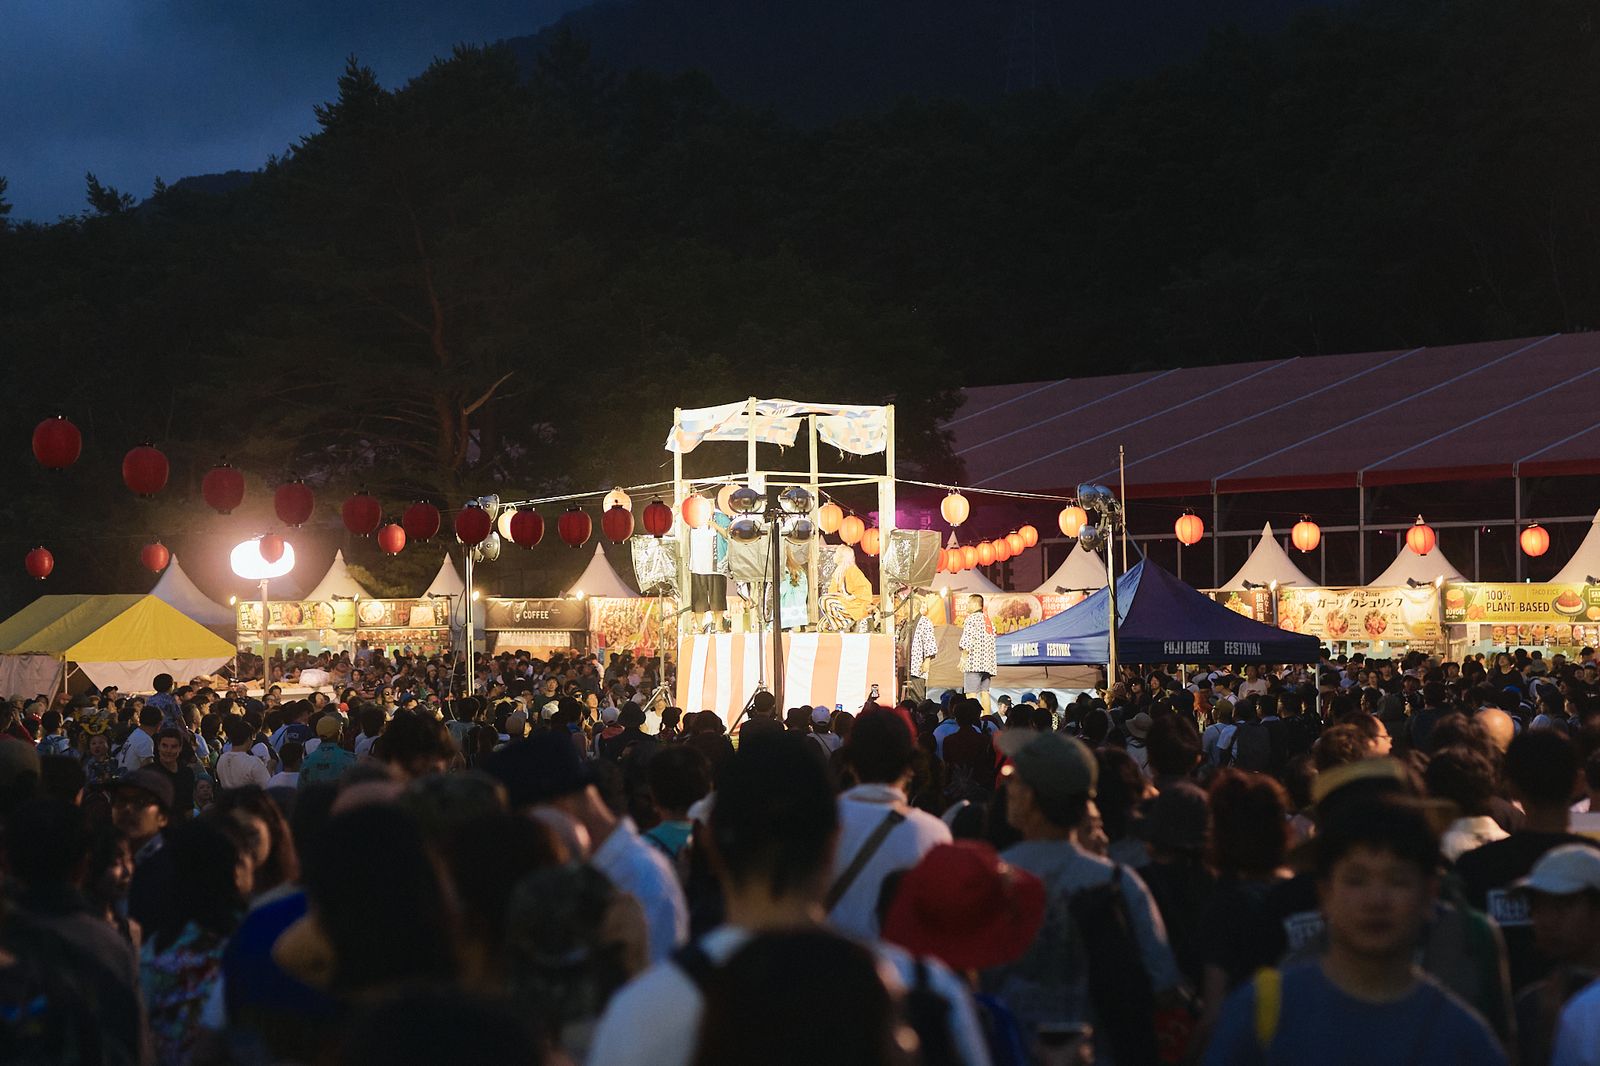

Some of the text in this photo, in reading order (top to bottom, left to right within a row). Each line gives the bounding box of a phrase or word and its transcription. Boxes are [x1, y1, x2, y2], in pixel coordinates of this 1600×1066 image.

[1486, 590, 1512, 600] 100%
[1317, 598, 1403, 609] ガーリクシュリンプ
[522, 610, 549, 620] COFFEE
[1163, 641, 1262, 656] FUJI ROCK FESTIVAL
